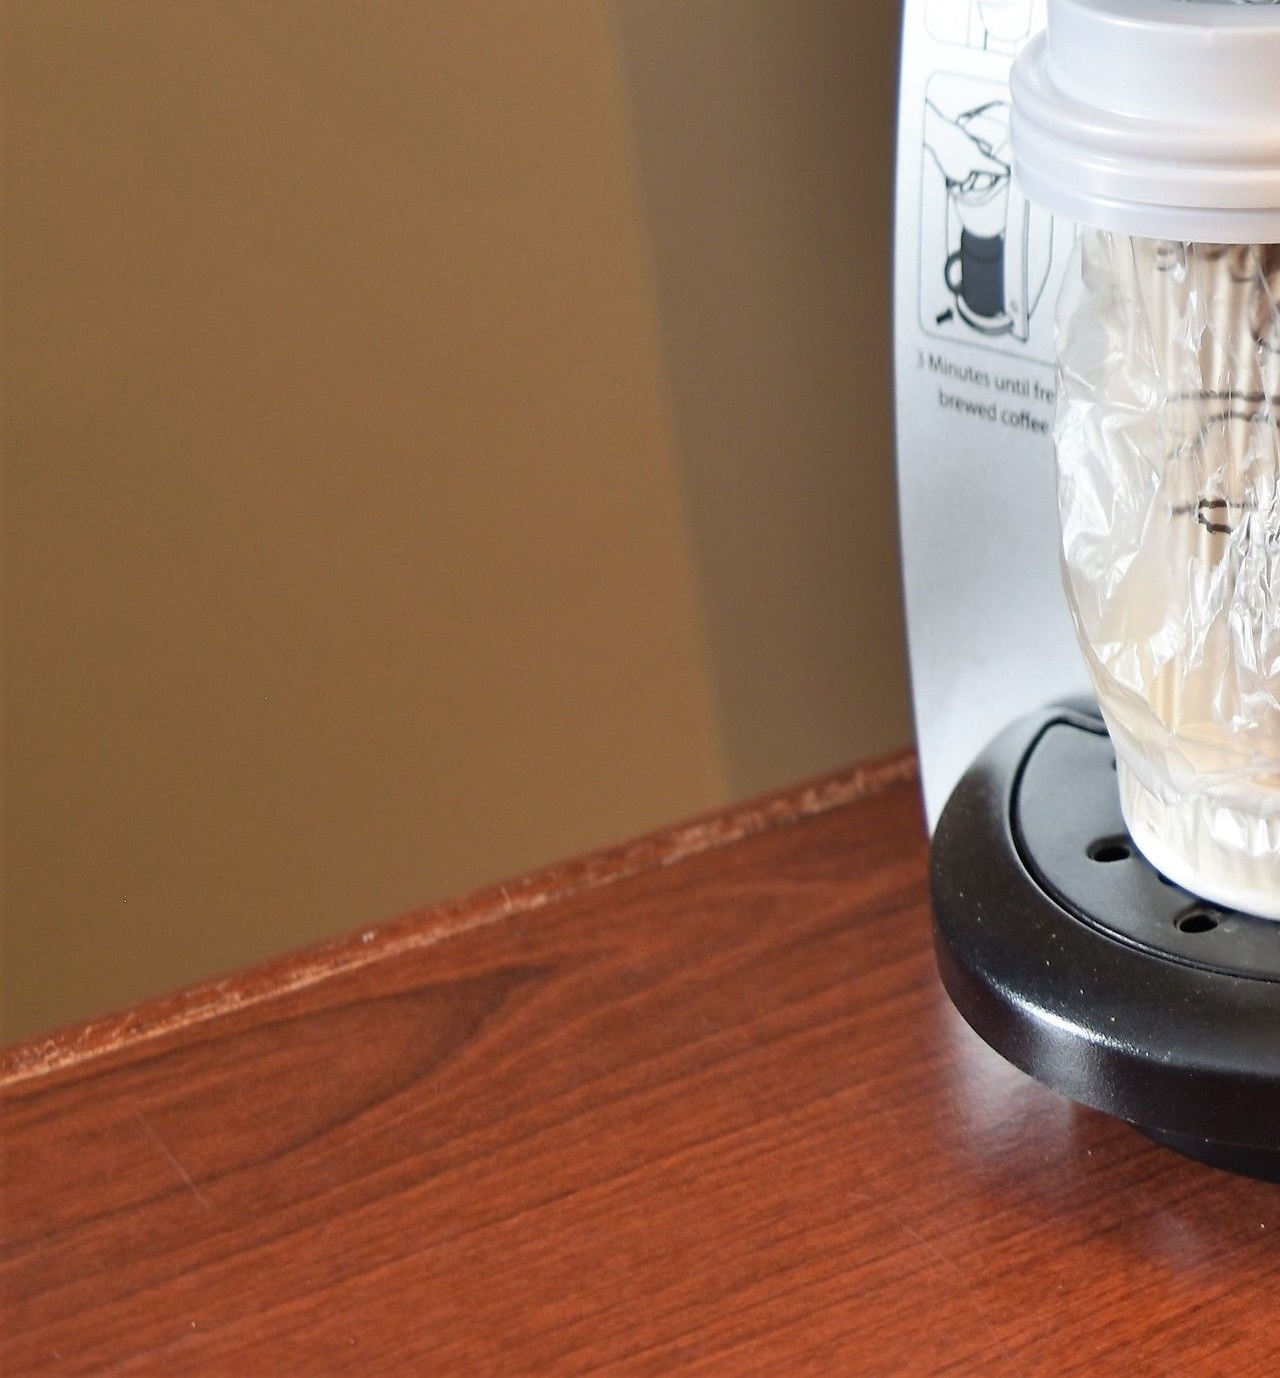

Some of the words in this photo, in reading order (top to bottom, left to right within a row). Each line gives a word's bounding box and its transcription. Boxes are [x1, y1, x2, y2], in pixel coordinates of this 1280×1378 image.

[928, 352, 991, 388] Minutes
[994, 375, 1030, 397] until
[938, 386, 998, 422] brewed
[1001, 408, 1049, 435] coffee
